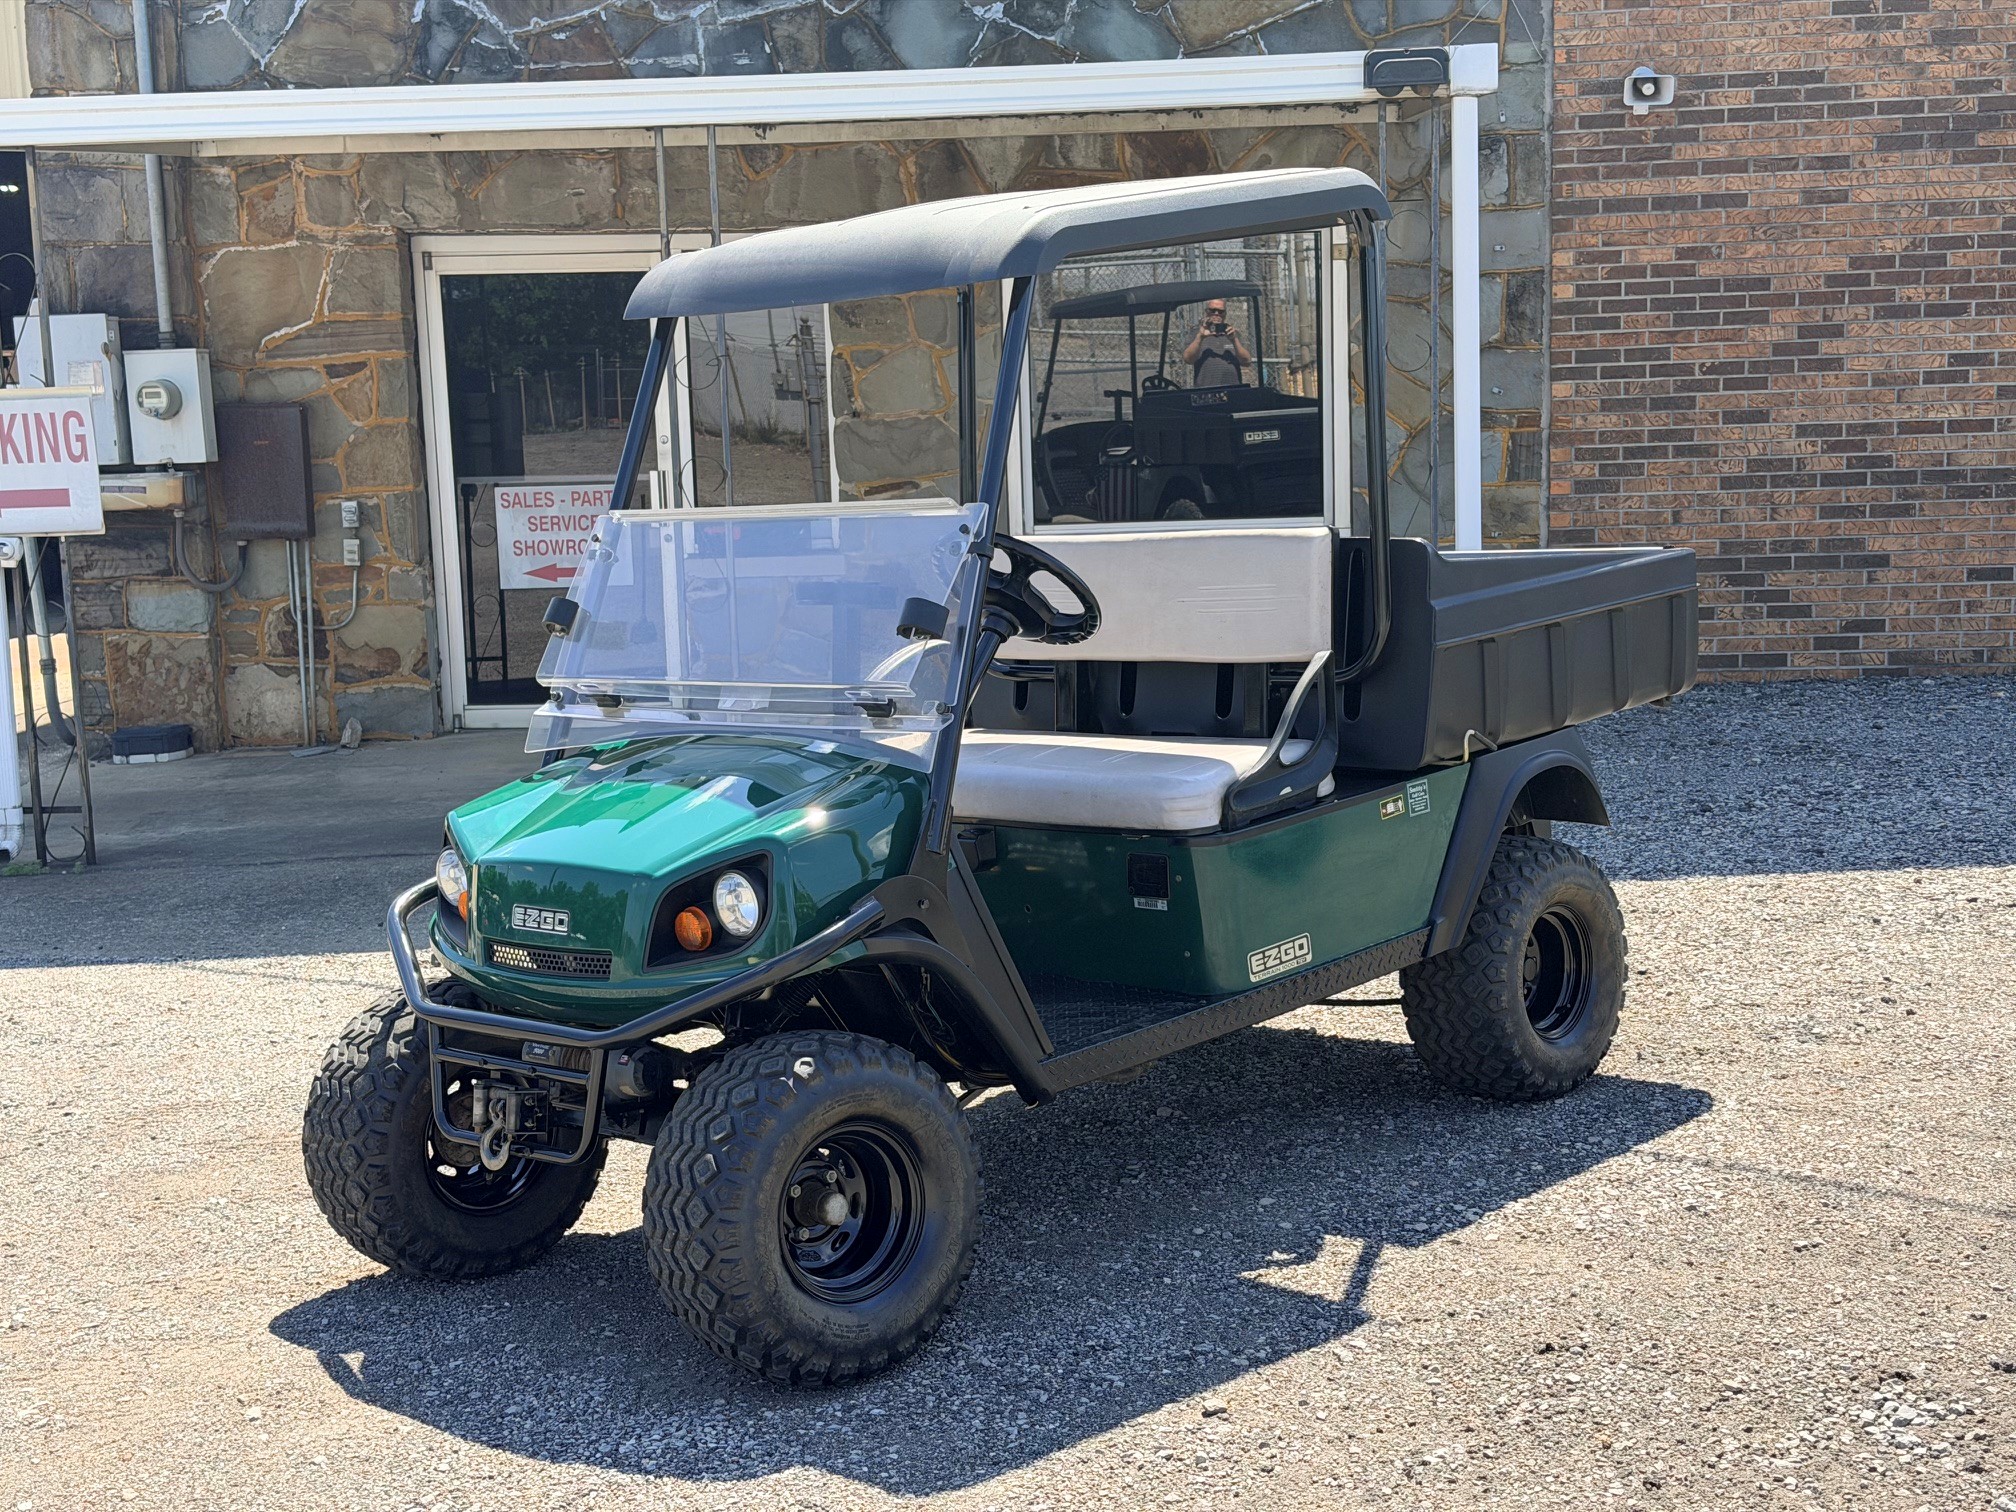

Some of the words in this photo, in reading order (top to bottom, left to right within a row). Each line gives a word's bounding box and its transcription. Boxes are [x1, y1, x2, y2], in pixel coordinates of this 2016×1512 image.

[0, 410, 89, 464] KING
[500, 491, 555, 509] SALES
[571, 490, 613, 507] PART
[513, 538, 589, 557] SHOWRO
